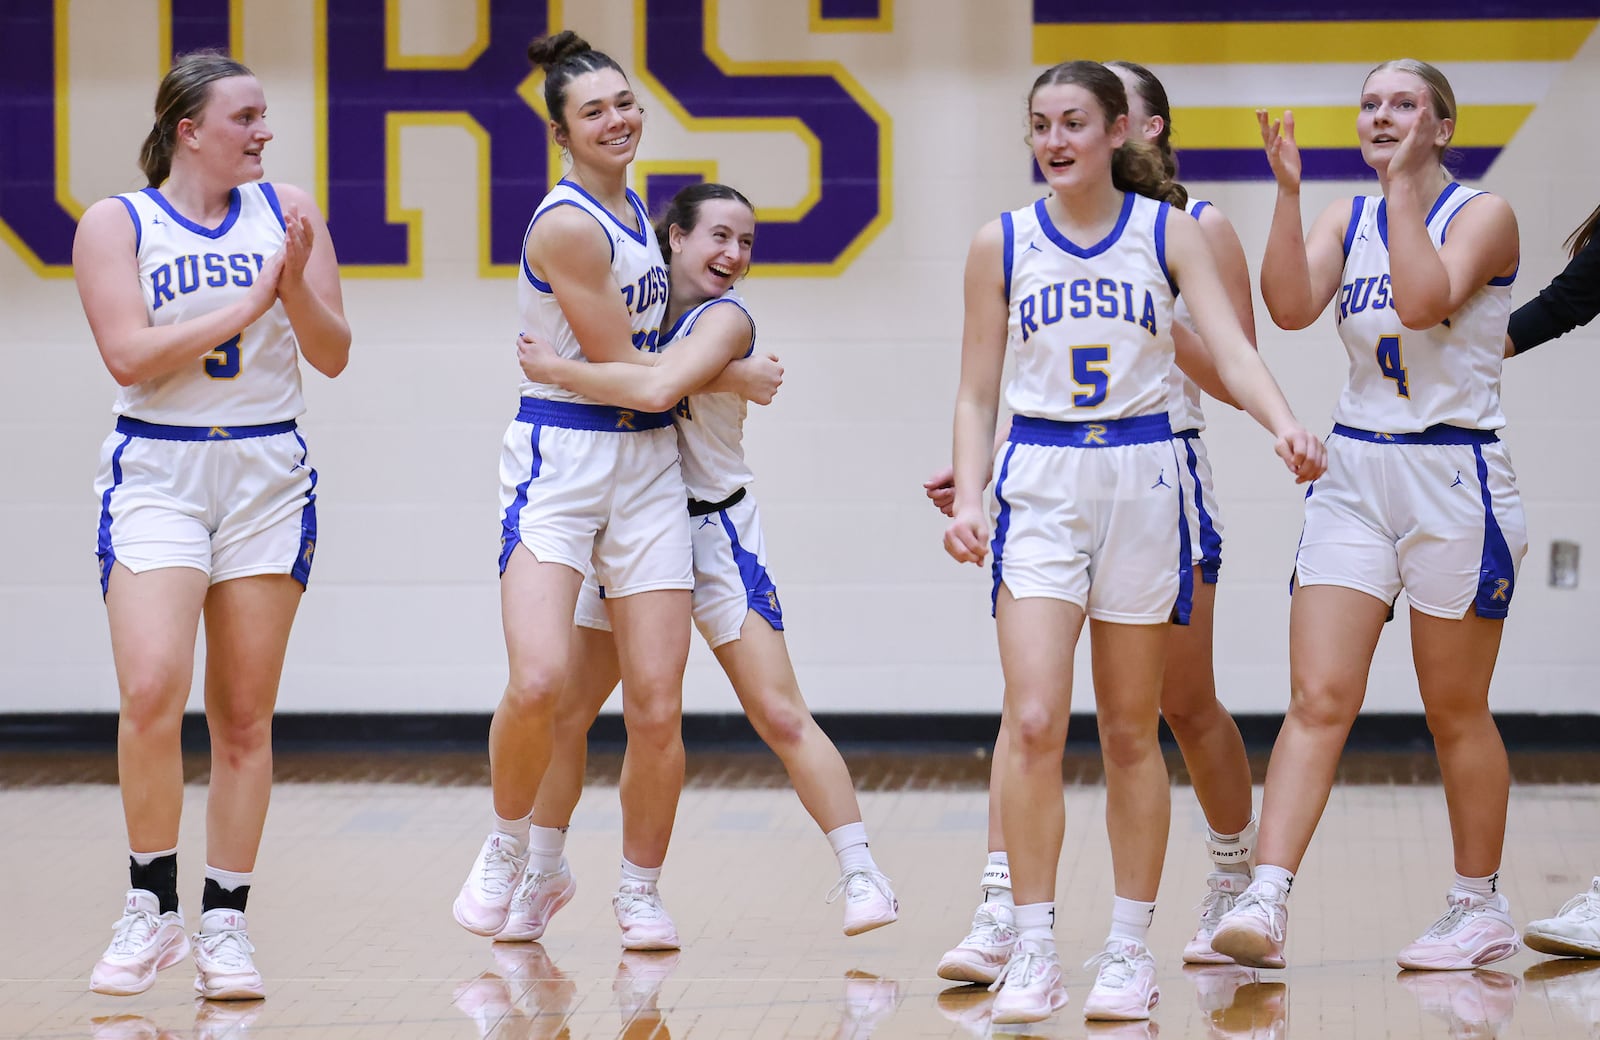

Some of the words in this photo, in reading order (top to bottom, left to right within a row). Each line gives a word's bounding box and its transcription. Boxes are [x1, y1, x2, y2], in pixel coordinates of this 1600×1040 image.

[1019, 278, 1158, 342] RUSSIA
[202, 331, 244, 381] 3
[1069, 343, 1111, 409] 5
[1376, 334, 1411, 400] 4
[1082, 423, 1108, 445] R
